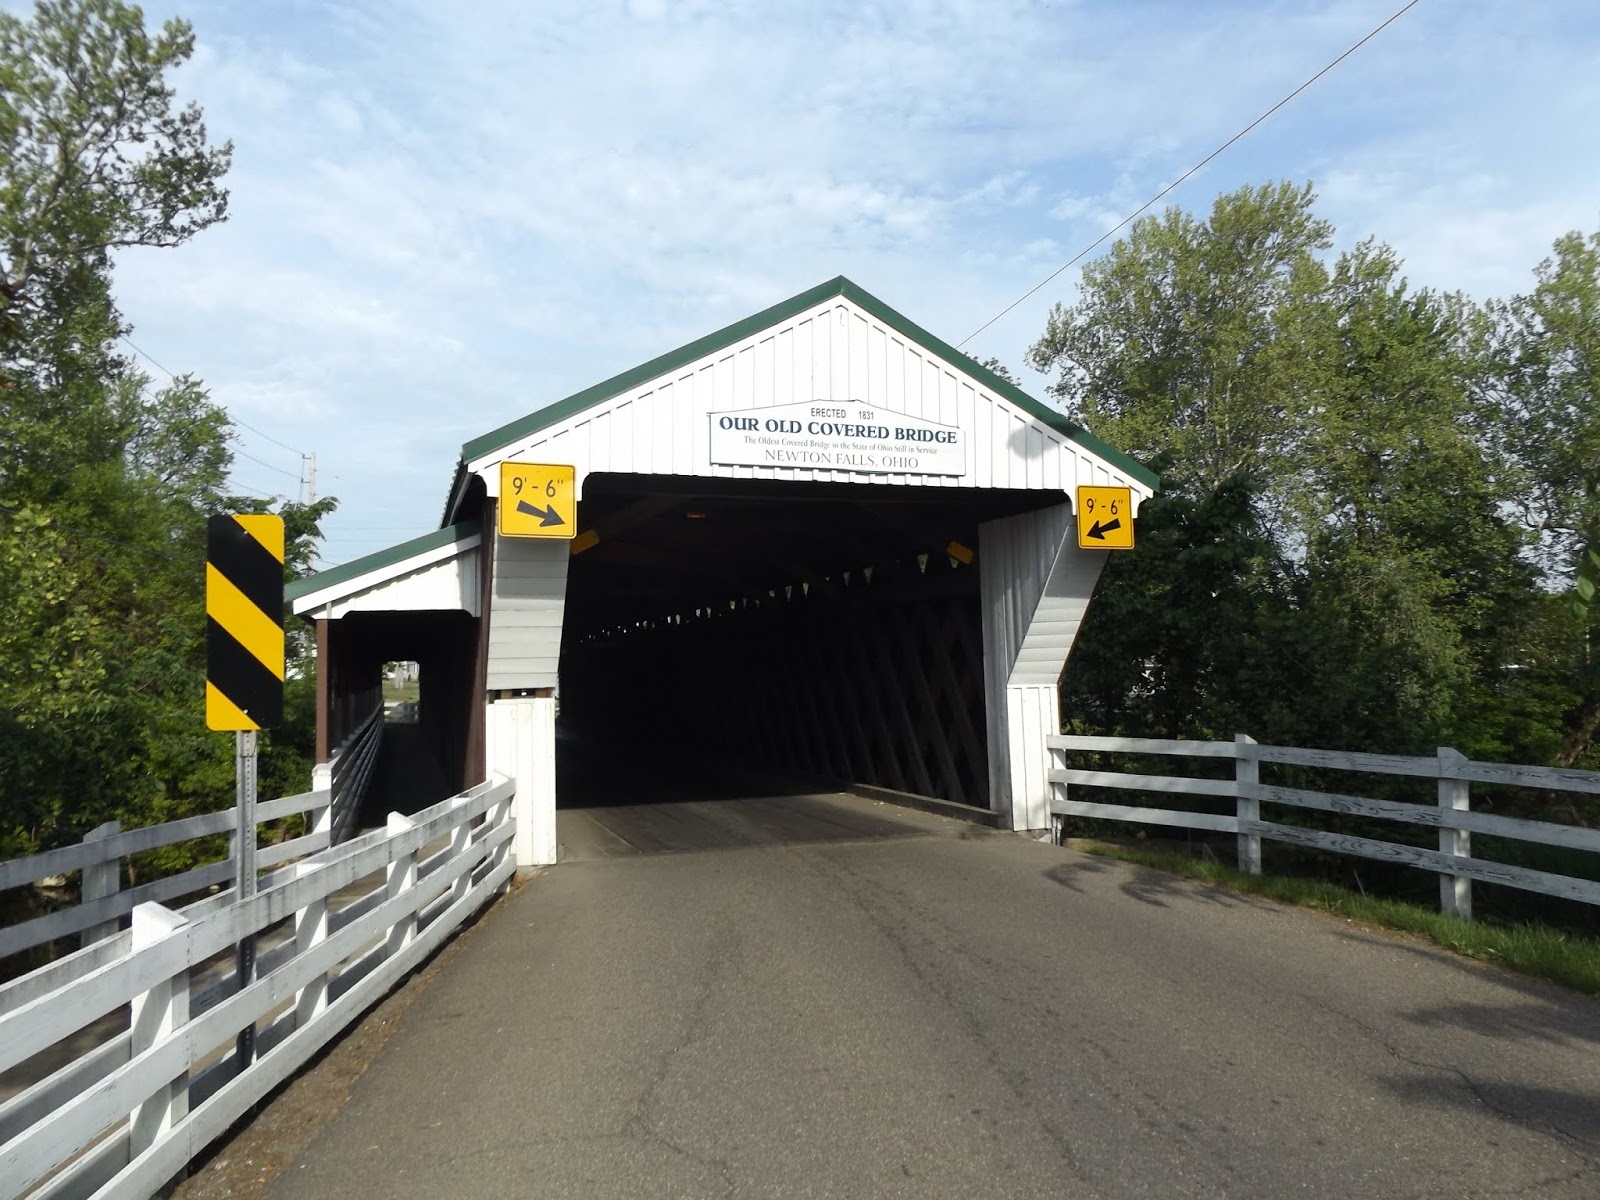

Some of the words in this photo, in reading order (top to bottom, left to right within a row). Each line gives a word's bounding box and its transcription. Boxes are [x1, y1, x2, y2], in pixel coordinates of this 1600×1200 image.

[811, 407, 846, 418] ERECTED
[858, 410, 875, 420] 1831
[719, 416, 760, 431] OUR
[765, 419, 803, 434] OLD
[807, 422, 890, 439] COVERED
[894, 427, 957, 444] BRIDGE
[744, 435, 757, 444] The
[758, 436, 780, 446] Oldest
[781, 438, 808, 447] Covered
[810, 440, 831, 450] Bridge
[840, 442, 851, 450] the
[852, 442, 868, 451] State
[869, 443, 876, 451] of
[877, 443, 893, 452] Ohio
[894, 444, 907, 453] Still
[916, 446, 938, 455] Service
[765, 449, 831, 464] NEWTON
[836, 453, 878, 468] FALLS,
[882, 455, 919, 469] OHIO
